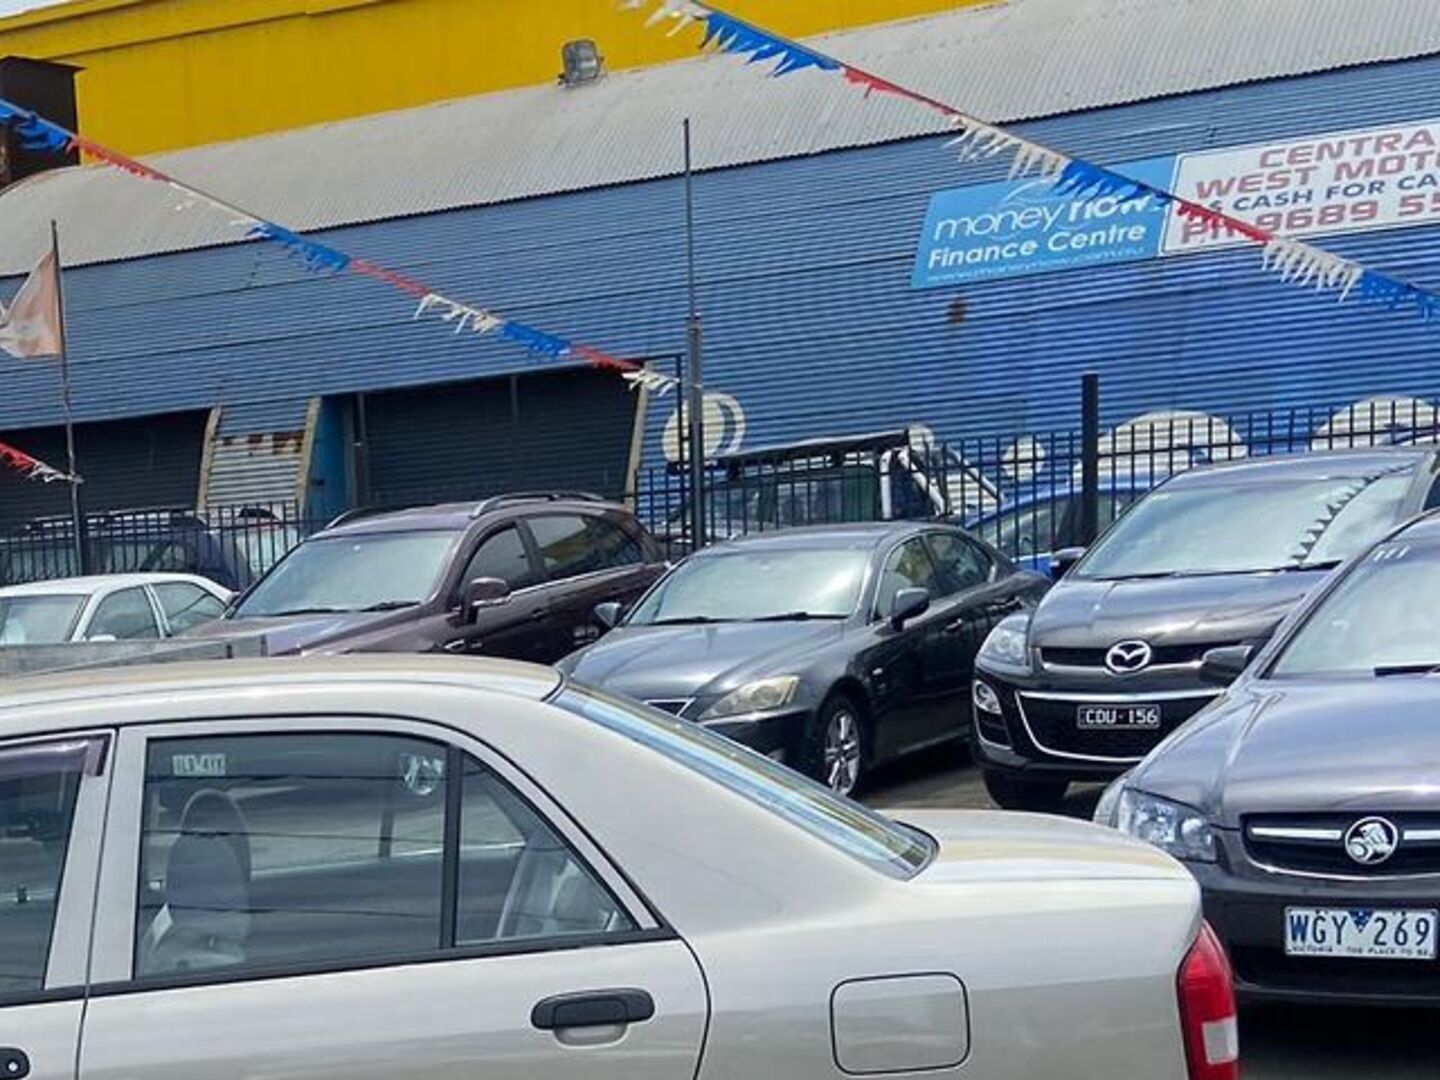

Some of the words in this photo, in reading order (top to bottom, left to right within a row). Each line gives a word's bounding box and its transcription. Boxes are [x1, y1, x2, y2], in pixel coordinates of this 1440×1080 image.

[1259, 128, 1437, 169] CENTRA
[1195, 166, 1319, 199] WEST
[1334, 150, 1440, 182] MOT
[1232, 189, 1313, 212] CASH
[1326, 180, 1385, 199] FOR
[933, 203, 1064, 240] money
[1255, 200, 1378, 235] 9689
[928, 239, 1039, 270] Finance
[1048, 224, 1146, 251] Centre
[1289, 914, 1348, 945] WGY
[1373, 916, 1430, 946] 269
